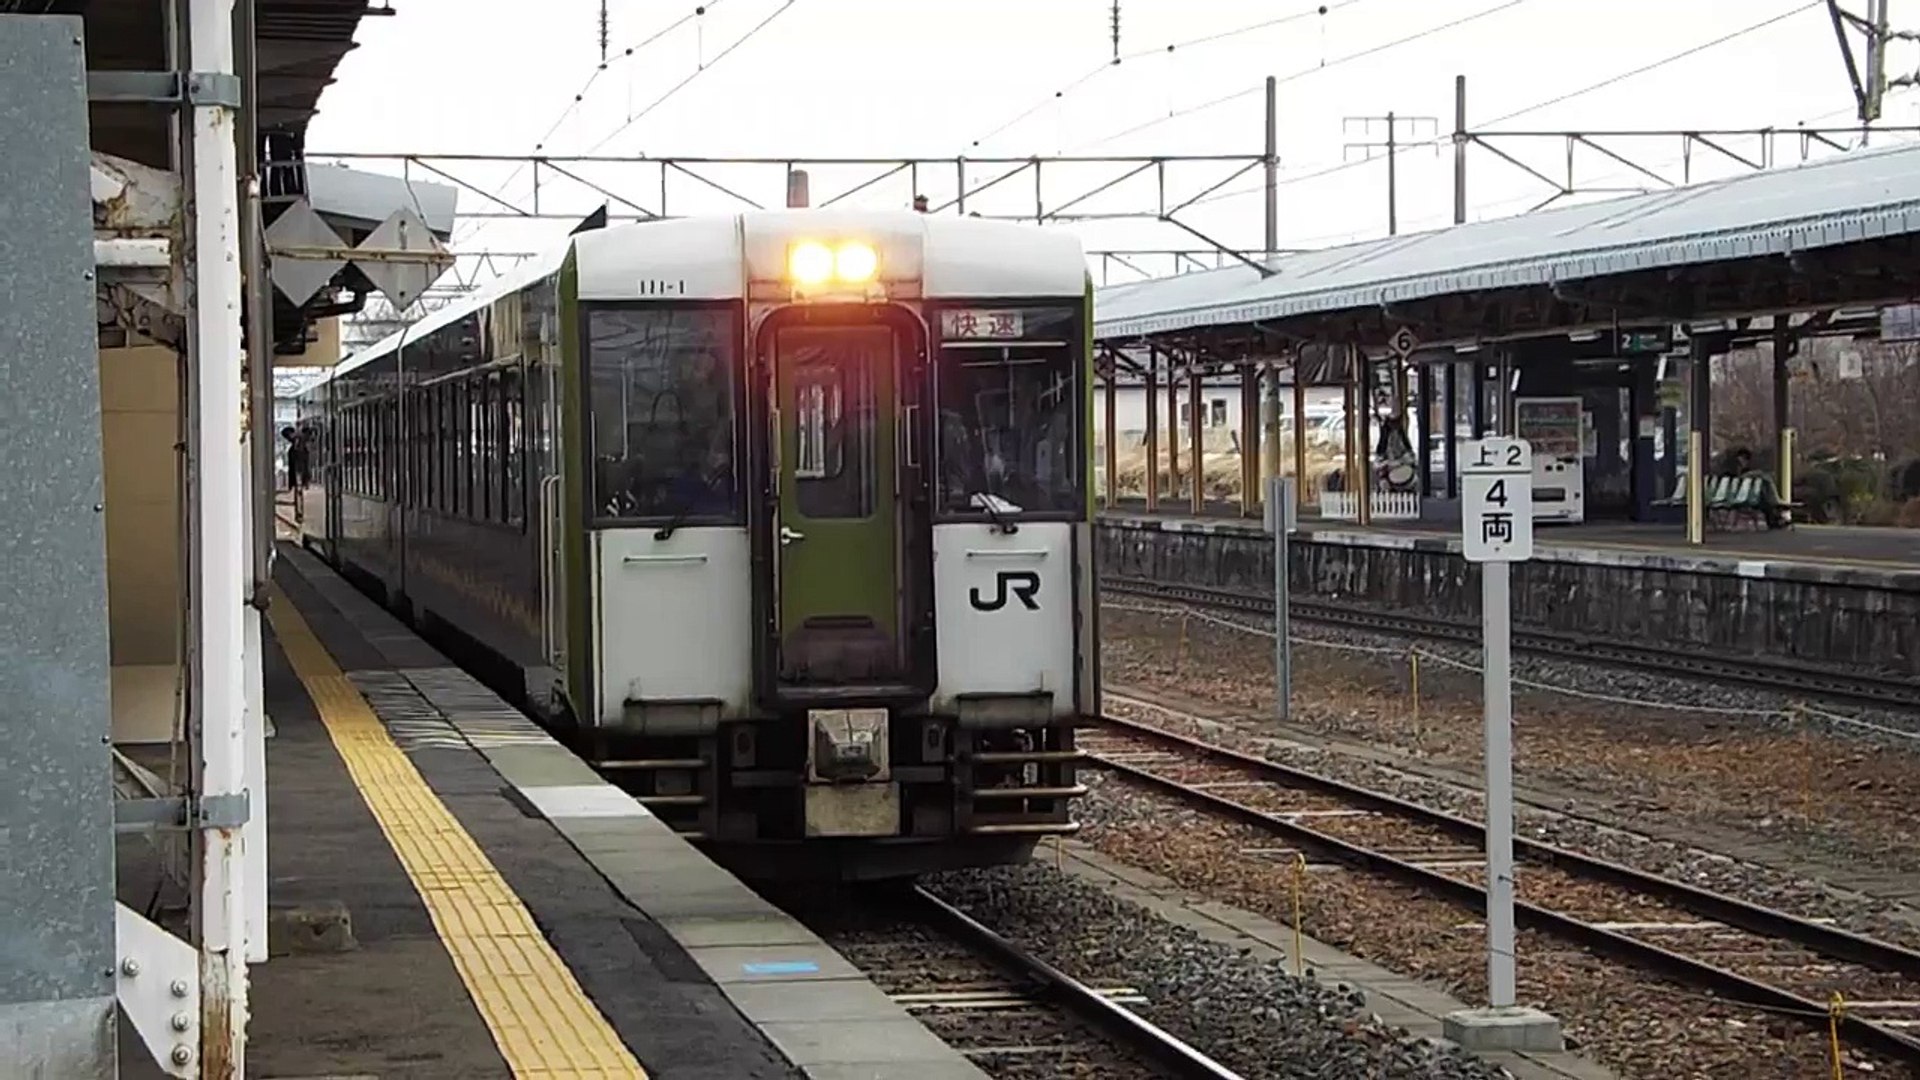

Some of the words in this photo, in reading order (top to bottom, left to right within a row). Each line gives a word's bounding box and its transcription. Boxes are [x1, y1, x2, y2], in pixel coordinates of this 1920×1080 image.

[641, 279, 684, 295] 111-1
[951, 312, 1015, 337] 快速
[1398, 331, 1410, 350] 6
[1621, 334, 1632, 349] 2
[969, 571, 1041, 612] JR
